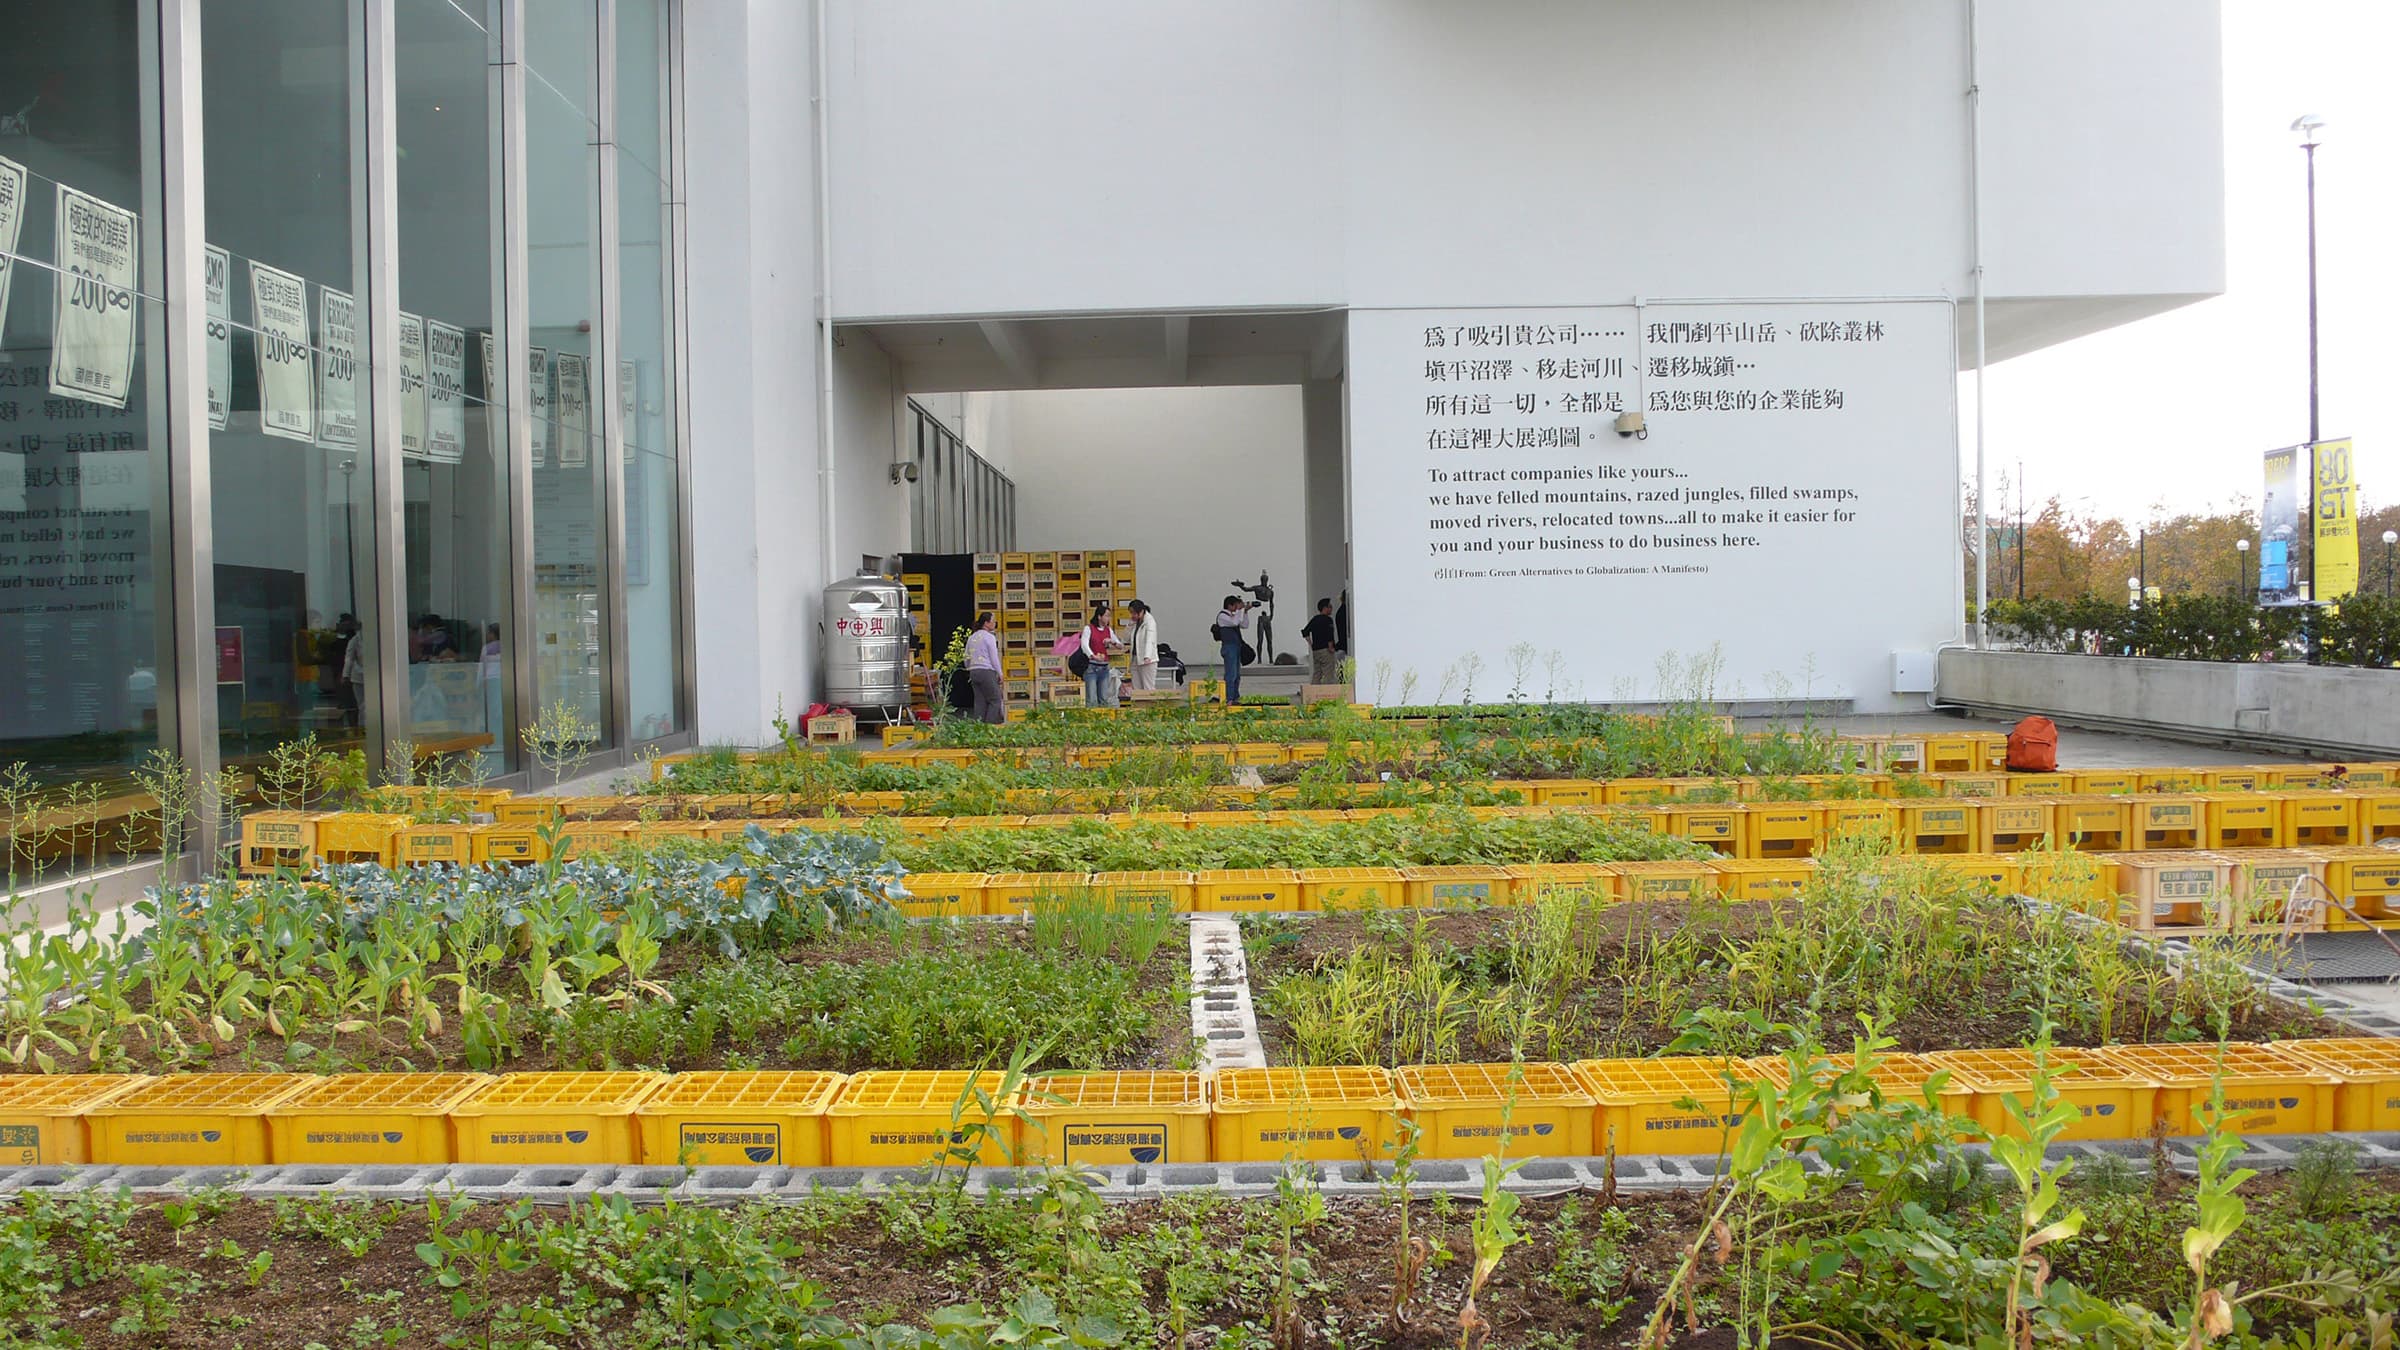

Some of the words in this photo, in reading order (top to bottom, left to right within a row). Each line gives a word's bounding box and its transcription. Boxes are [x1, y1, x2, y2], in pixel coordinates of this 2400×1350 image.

[1428, 468, 1448, 483] To
[1453, 468, 1506, 482] attract
[1511, 466, 1593, 484] companies
[1599, 464, 1627, 480] like
[1631, 467, 1688, 483] yours...
[1429, 495, 1451, 506] we
[1456, 491, 1492, 506] have
[1497, 489, 1540, 505] felled
[1545, 488, 1632, 506] mountains,
[1637, 487, 1680, 502] razed
[1684, 487, 1744, 505] jungles,
[1750, 485, 1788, 500] filled
[1793, 488, 1859, 503] swamps,
[1430, 514, 1481, 530] moved
[1488, 513, 1538, 530] rivers,
[1543, 511, 1614, 527] relocated
[1703, 511, 1717, 524] to
[1722, 509, 1764, 524] make
[1769, 508, 1779, 523] it
[1784, 508, 1830, 523] easier
[1834, 507, 1857, 522] for
[1430, 541, 1459, 557] you
[1464, 537, 1493, 552] and
[1498, 540, 1535, 555] your
[1540, 535, 1605, 551] business
[1610, 536, 1624, 549] to
[1629, 534, 1648, 549] do
[1653, 533, 1718, 549] business
[1723, 532, 1760, 547] here.
[1489, 568, 1517, 578] Green
[1519, 566, 1573, 577] Alternatives
[1575, 567, 1585, 576] to
[1587, 565, 1649, 576] Globalization:
[1661, 563, 1709, 575] Manifesto)
